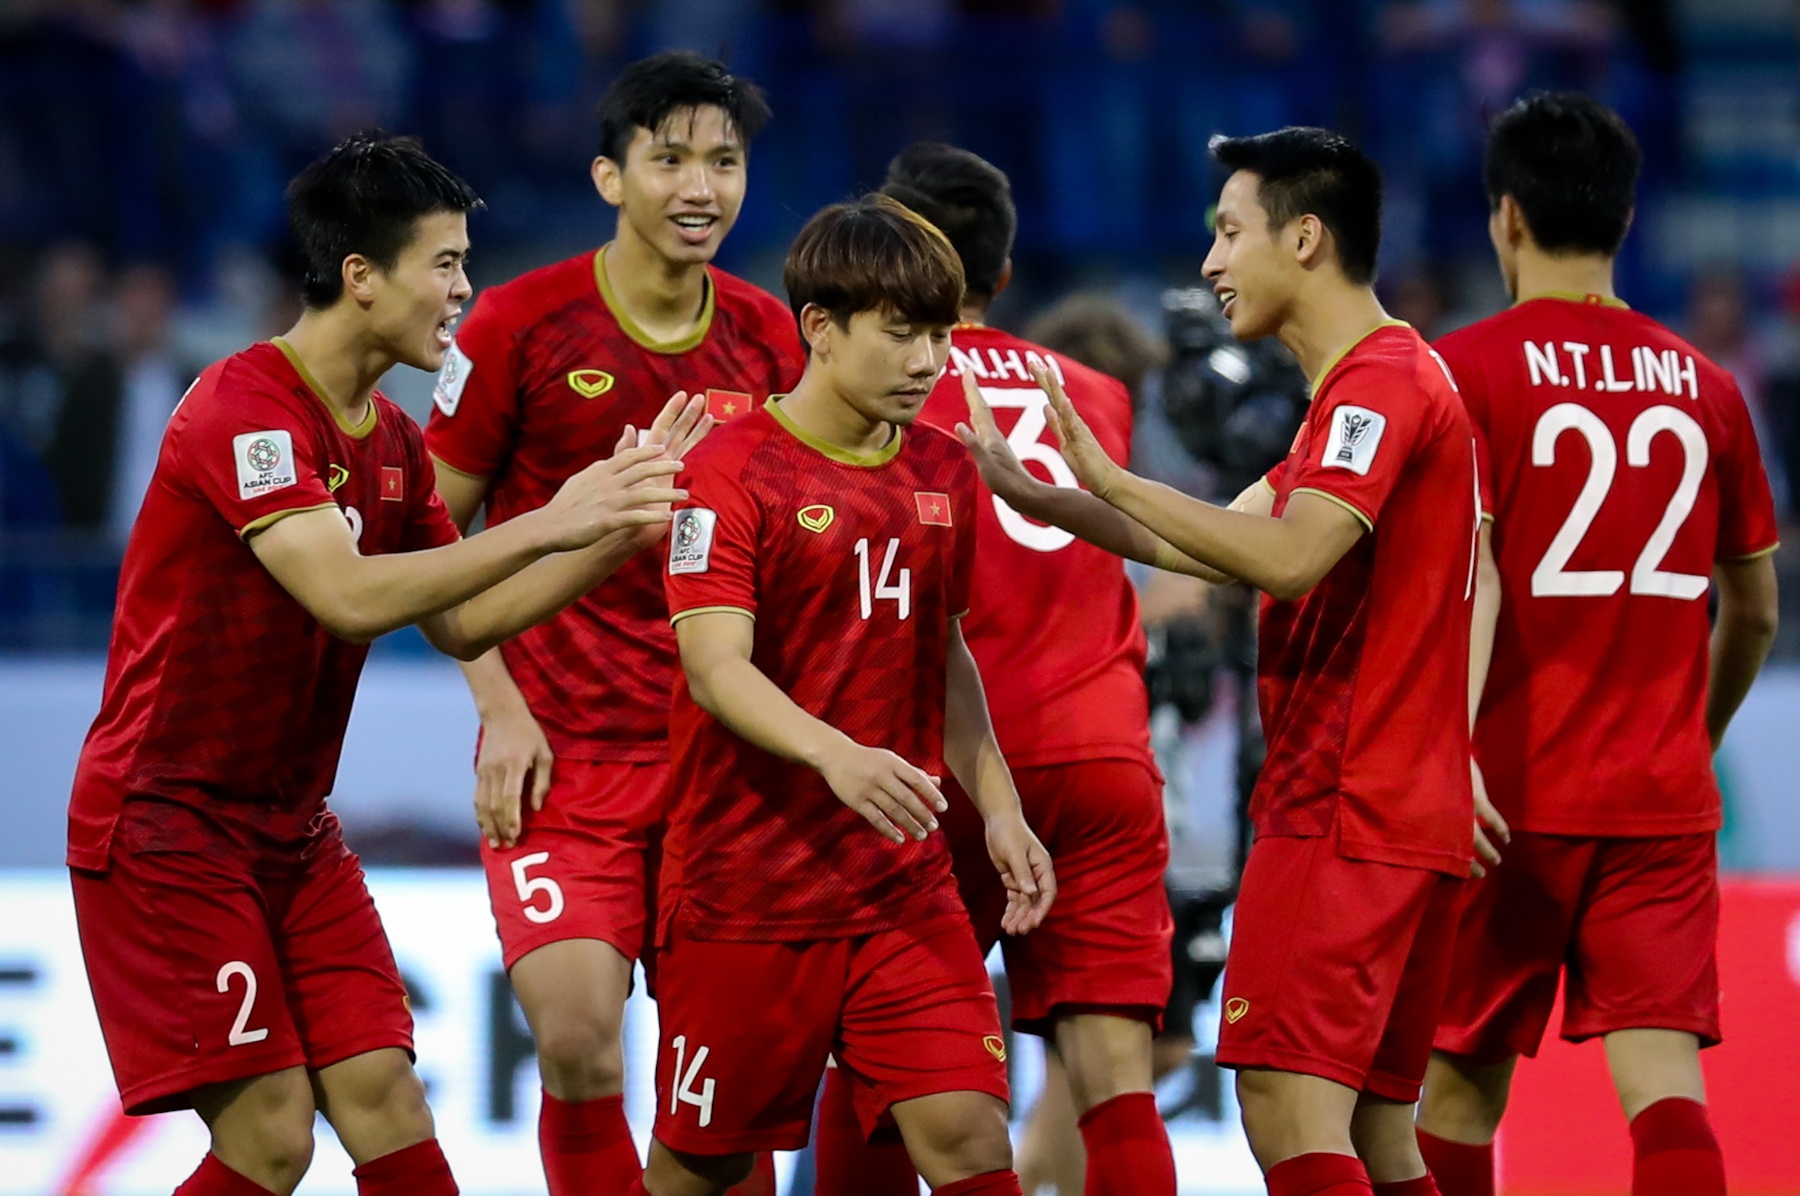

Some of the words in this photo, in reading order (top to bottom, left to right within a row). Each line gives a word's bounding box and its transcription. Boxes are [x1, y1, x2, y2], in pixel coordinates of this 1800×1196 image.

[1522, 340, 1700, 400] N.T.LINH
[243, 479, 271, 489] ASIAN
[977, 386, 1080, 553] 3
[1531, 402, 1710, 600] 22
[854, 537, 911, 620] 14
[510, 851, 565, 924] 5
[216, 960, 269, 1046] 2
[671, 1034, 716, 1128] 14
